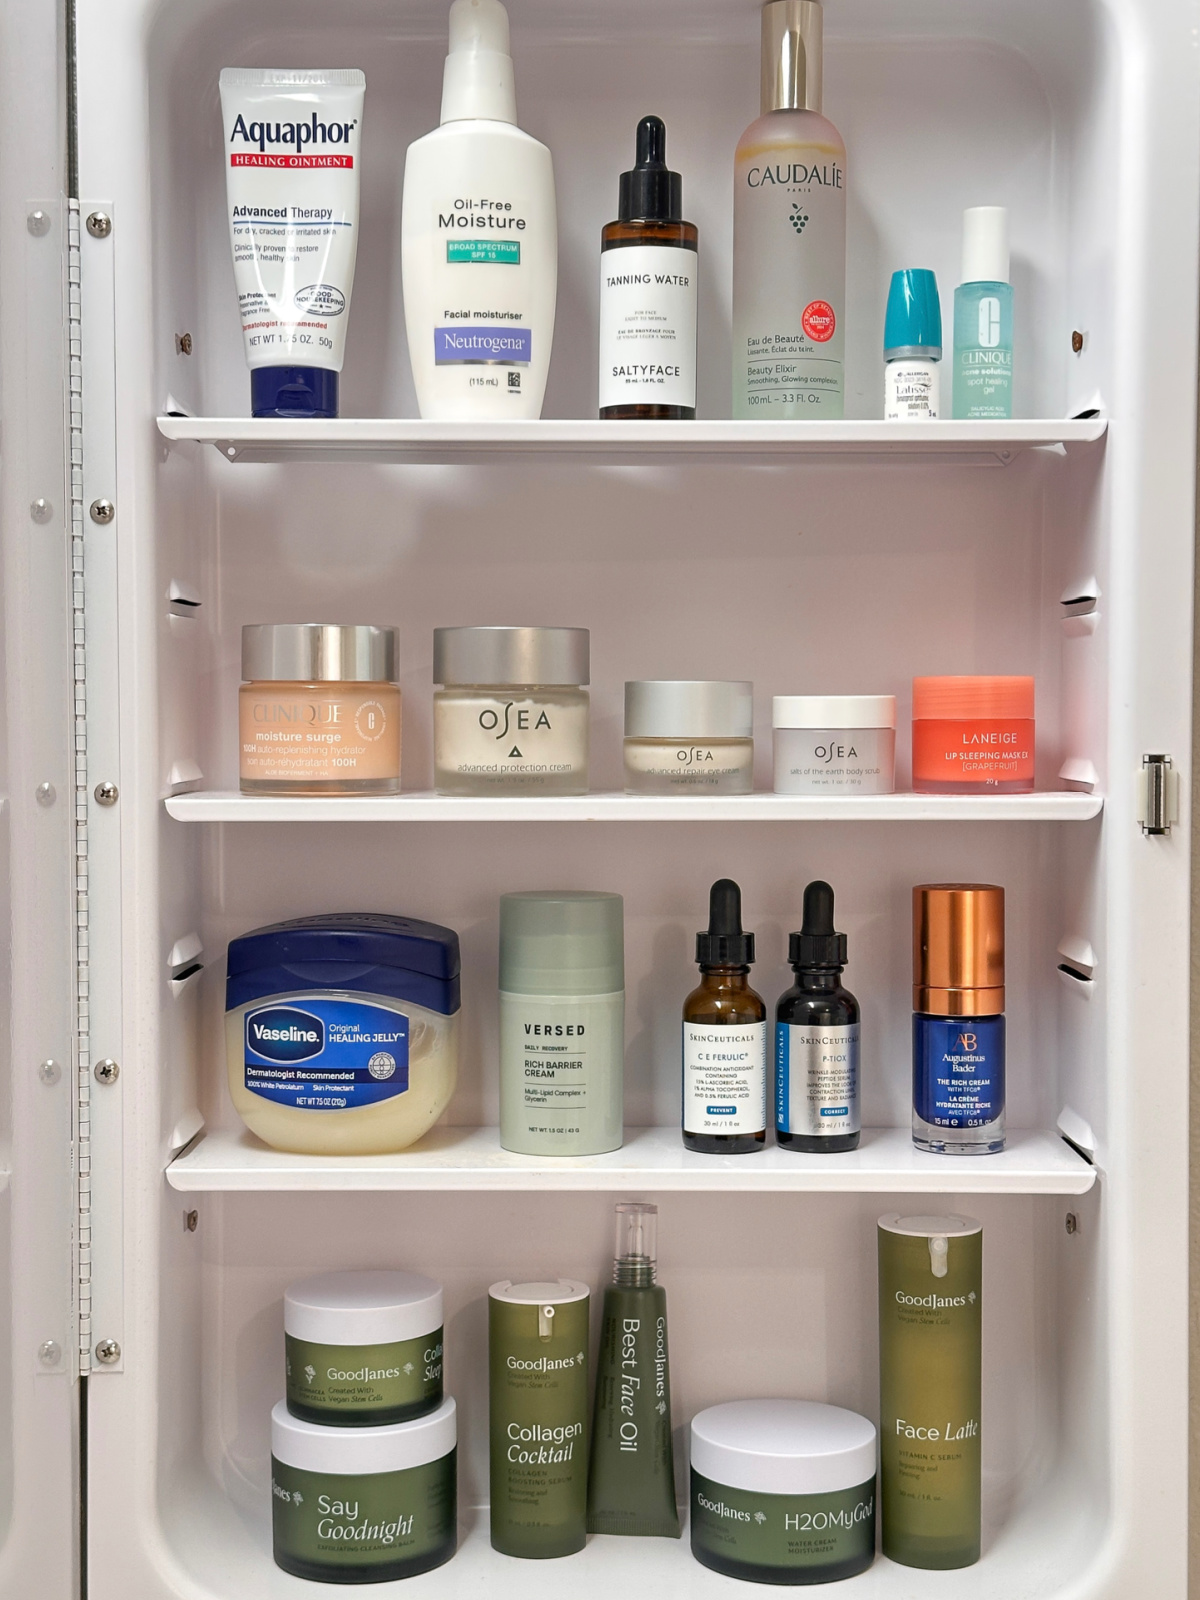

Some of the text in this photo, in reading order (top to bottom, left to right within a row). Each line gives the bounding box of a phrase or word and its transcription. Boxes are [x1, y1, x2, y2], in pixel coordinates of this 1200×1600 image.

[236, 156, 347, 166] HEALING OINTMENT
[454, 199, 512, 211] Oil-Free
[233, 206, 332, 219] Advanced Therapy
[439, 214, 526, 229] Moisture
[607, 274, 689, 287] TANNING WATER
[444, 311, 522, 320] Facial moisturiser
[250, 336, 261, 346] NET
[263, 334, 274, 343] WT
[319, 337, 332, 349] 50g
[748, 335, 804, 346] Eau de Beauté
[613, 365, 680, 376] SALTYFACE
[776, 365, 796, 373] Elixir
[470, 378, 484, 386] (115
[253, 704, 343, 725] CLINIQUE
[479, 702, 551, 739] OSEA
[256, 731, 342, 743] moisture surge
[963, 733, 1017, 744] LANEIGE
[258, 745, 328, 756] auto-replenishing
[331, 745, 366, 755] hydrator
[677, 747, 713, 765] OSEA
[815, 742, 857, 763] OSEA
[458, 763, 571, 773] advanced protection cream
[846, 768, 863, 776] body
[963, 762, 1017, 771] [GRAPEFRUIT]
[329, 1024, 360, 1033] Original
[525, 1024, 585, 1036] VERSED
[329, 1034, 370, 1042] HEALING
[525, 1060, 544, 1068] RICH
[942, 1054, 985, 1064] Augustinus
[247, 1068, 354, 1079] Dermatologist Recommended
[525, 1069, 554, 1077] CREAM
[896, 1291, 965, 1309] GoodJanes
[654, 1317, 666, 1396] GoodJanes
[507, 1356, 575, 1373] GoodJanes
[327, 1368, 399, 1383] GoodJanes
[620, 1319, 640, 1451] Best Face Oil
[507, 1422, 582, 1444] Collagen
[896, 1419, 978, 1441] Face Latte
[507, 1442, 573, 1464] Cocktail
[318, 1495, 359, 1520] Say
[698, 1493, 750, 1522] GoodJanes
[317, 1515, 414, 1543] Goodnight
[789, 1546, 833, 1554] MOISTURIZER
